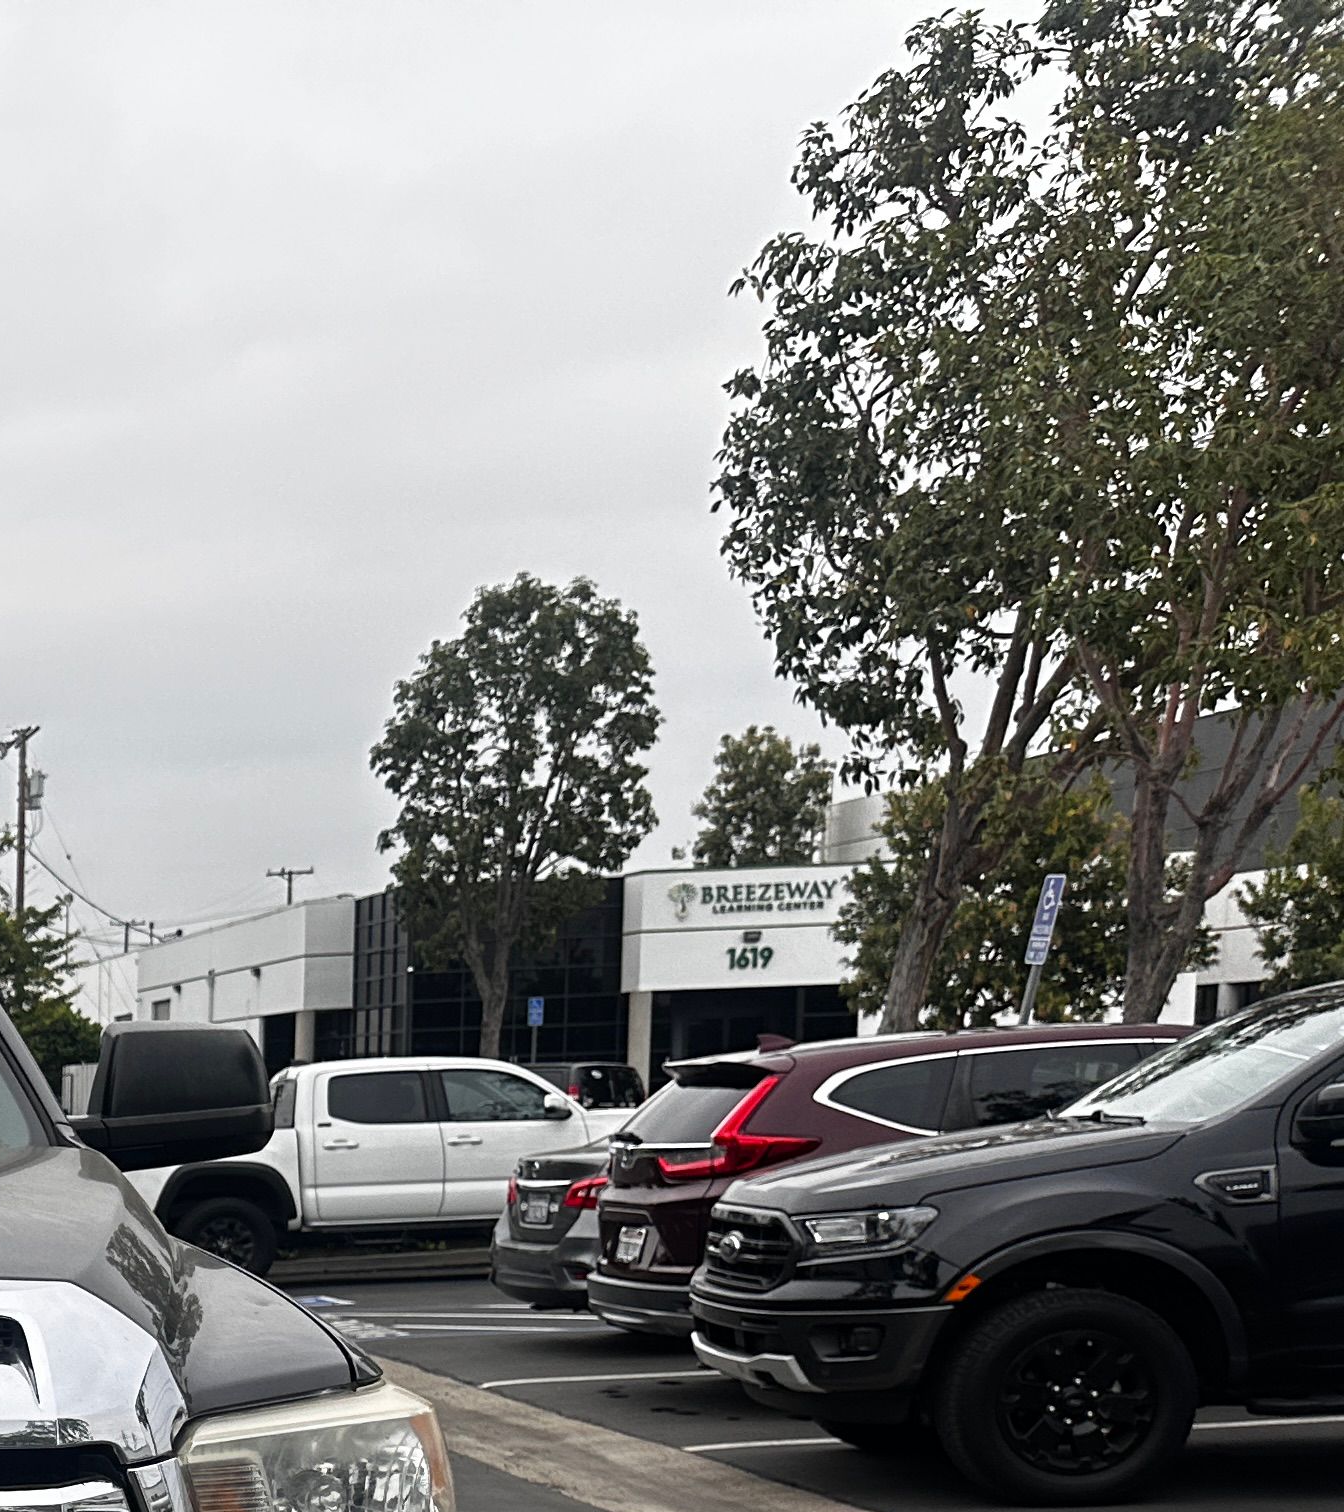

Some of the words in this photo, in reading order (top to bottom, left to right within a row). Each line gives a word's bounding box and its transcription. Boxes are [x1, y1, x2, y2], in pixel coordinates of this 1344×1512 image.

[700, 880, 838, 904] BREEZEWAY
[712, 903, 773, 914] LEARNING
[777, 901, 824, 911] CENTER
[725, 946, 774, 970] 1619
